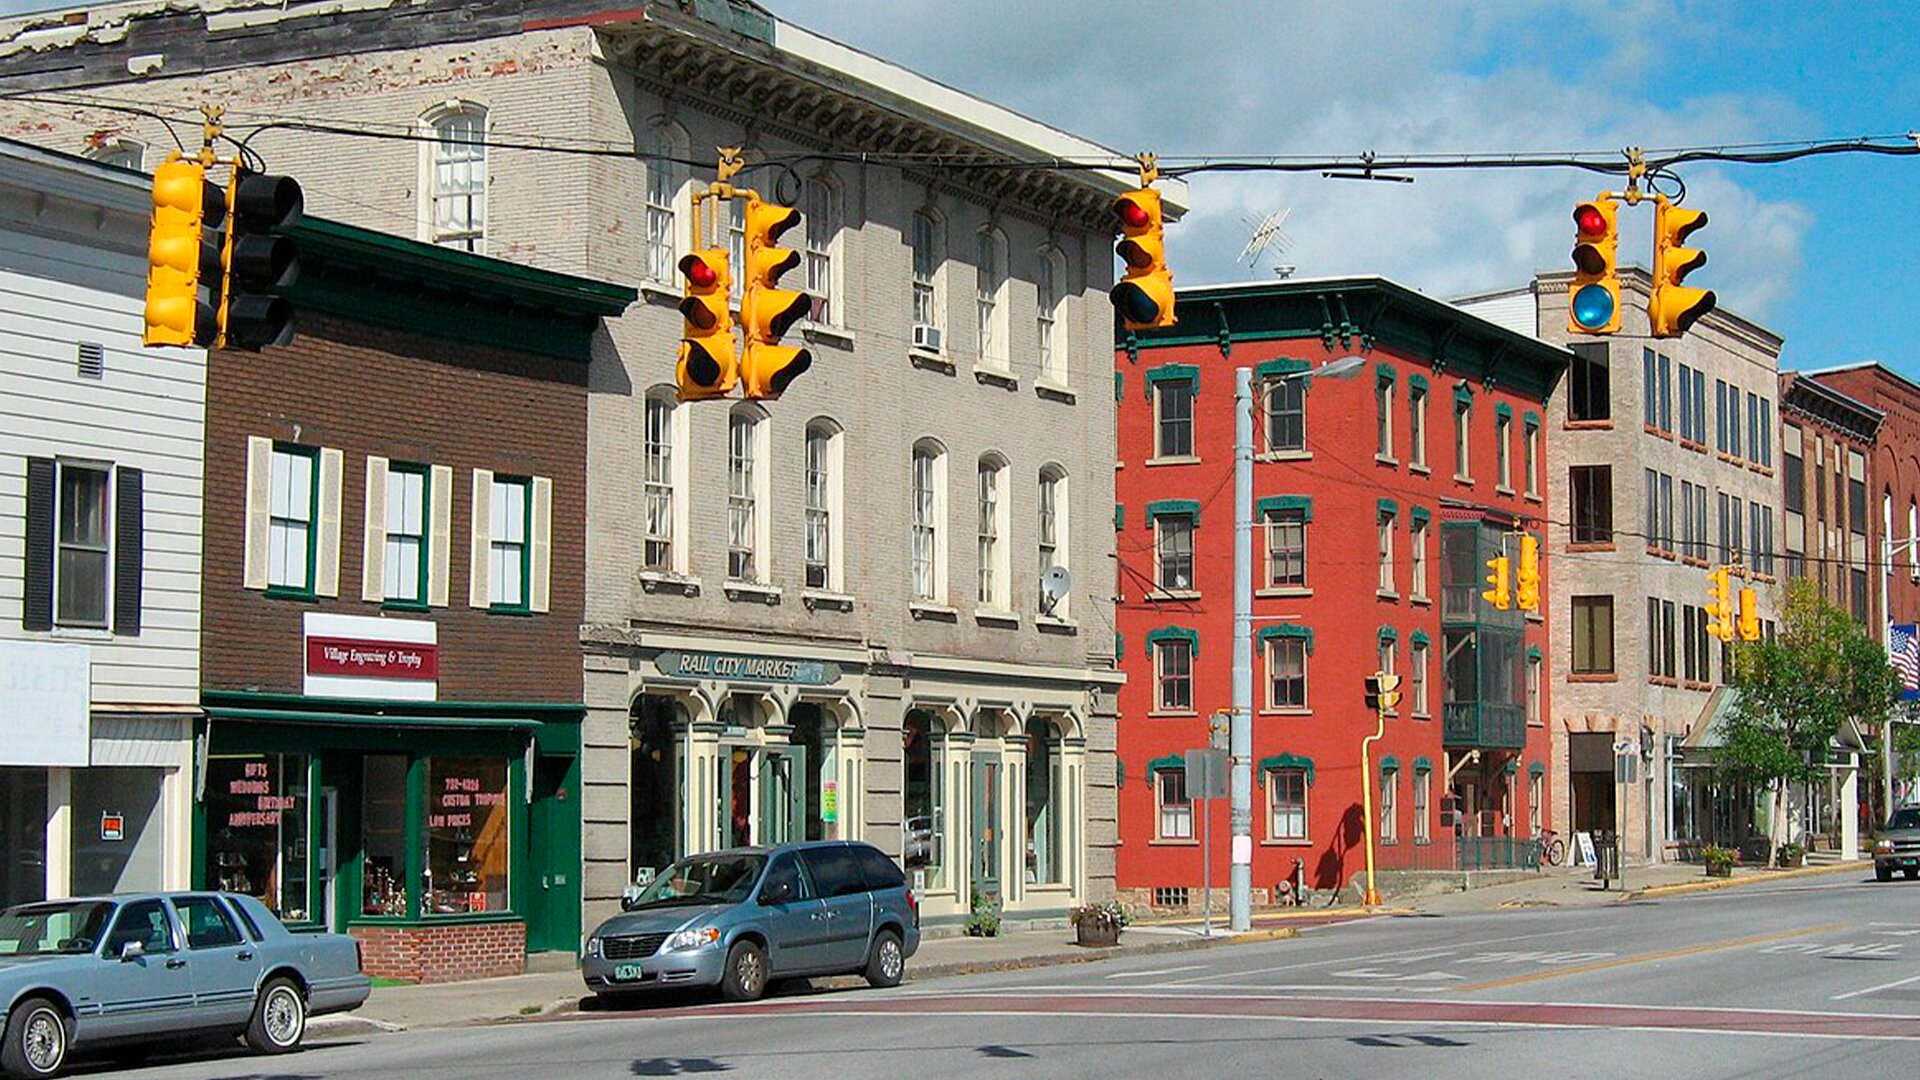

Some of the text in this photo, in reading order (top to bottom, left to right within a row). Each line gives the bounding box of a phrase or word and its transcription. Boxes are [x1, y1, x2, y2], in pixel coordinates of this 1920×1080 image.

[323, 646, 422, 669] Village Engraving & Trophy
[679, 654, 711, 672] RAIL
[713, 656, 745, 675] CITY
